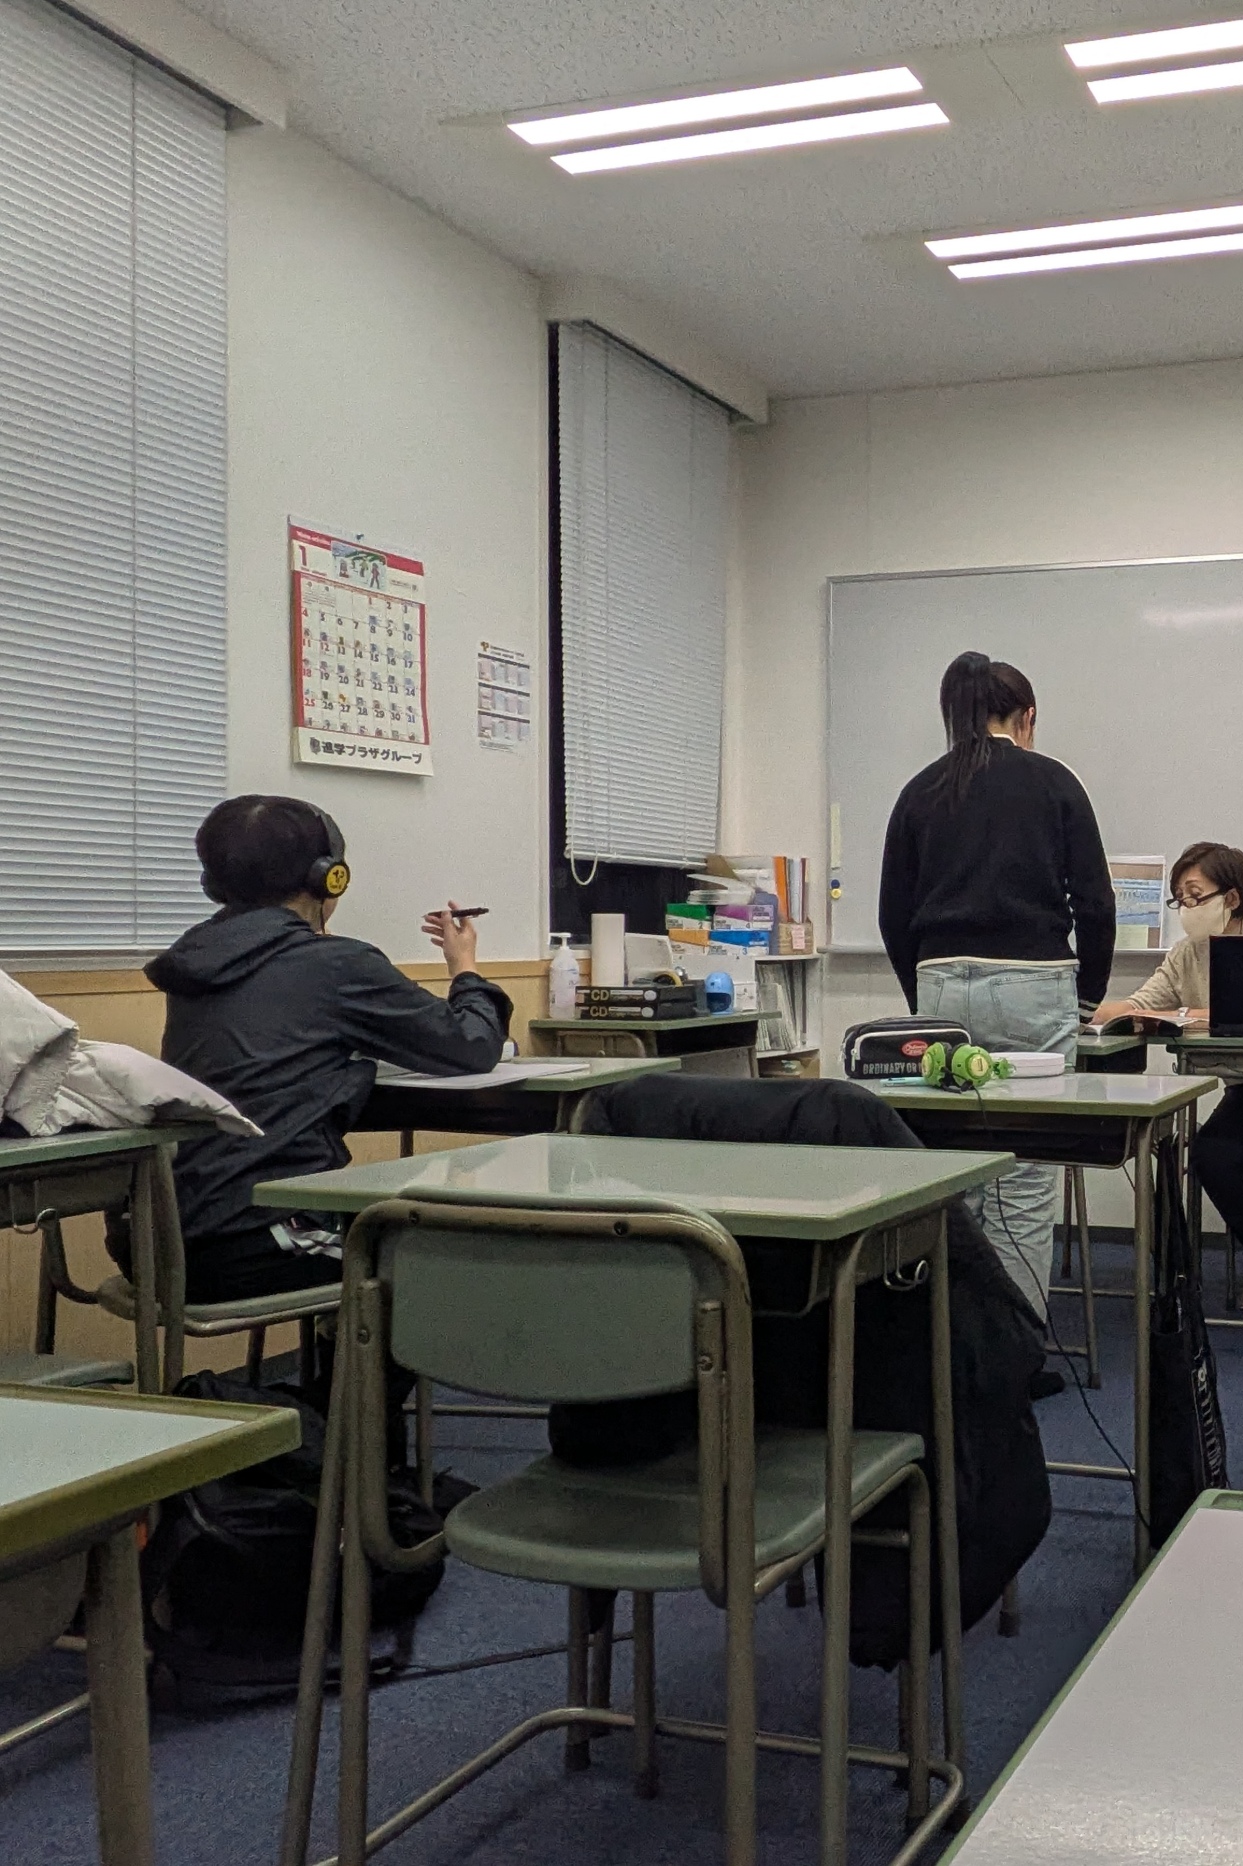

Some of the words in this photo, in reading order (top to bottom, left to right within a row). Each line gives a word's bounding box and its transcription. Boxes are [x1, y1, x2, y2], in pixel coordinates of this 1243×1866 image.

[298, 545, 307, 566] 1
[386, 602, 392, 610] 2
[302, 608, 308, 617] 4
[321, 612, 325, 621] 5
[353, 621, 359, 629] 7
[370, 625, 376, 634] 8
[387, 629, 392, 637] 9
[403, 632, 413, 641] 10
[303, 639, 311, 647] 11
[320, 642, 329, 651] 12
[354, 649, 363, 659] 14
[370, 653, 379, 662] 15
[387, 657, 396, 666] 16
[404, 660, 413, 669] 17
[303, 668, 312, 678] 18
[320, 672, 329, 680] 19
[338, 675, 349, 684] 20
[356, 678, 364, 688] 21
[372, 682, 382, 691] 22
[405, 688, 416, 696] 24
[304, 698, 315, 707] 25
[340, 704, 351, 712] 27
[358, 707, 368, 716] 28
[374, 710, 385, 718] 29
[391, 712, 401, 721] 30
[591, 990, 609, 1000] CD
[590, 1006, 608, 1016] CD
[863, 1062, 905, 1074] ORDINARY
